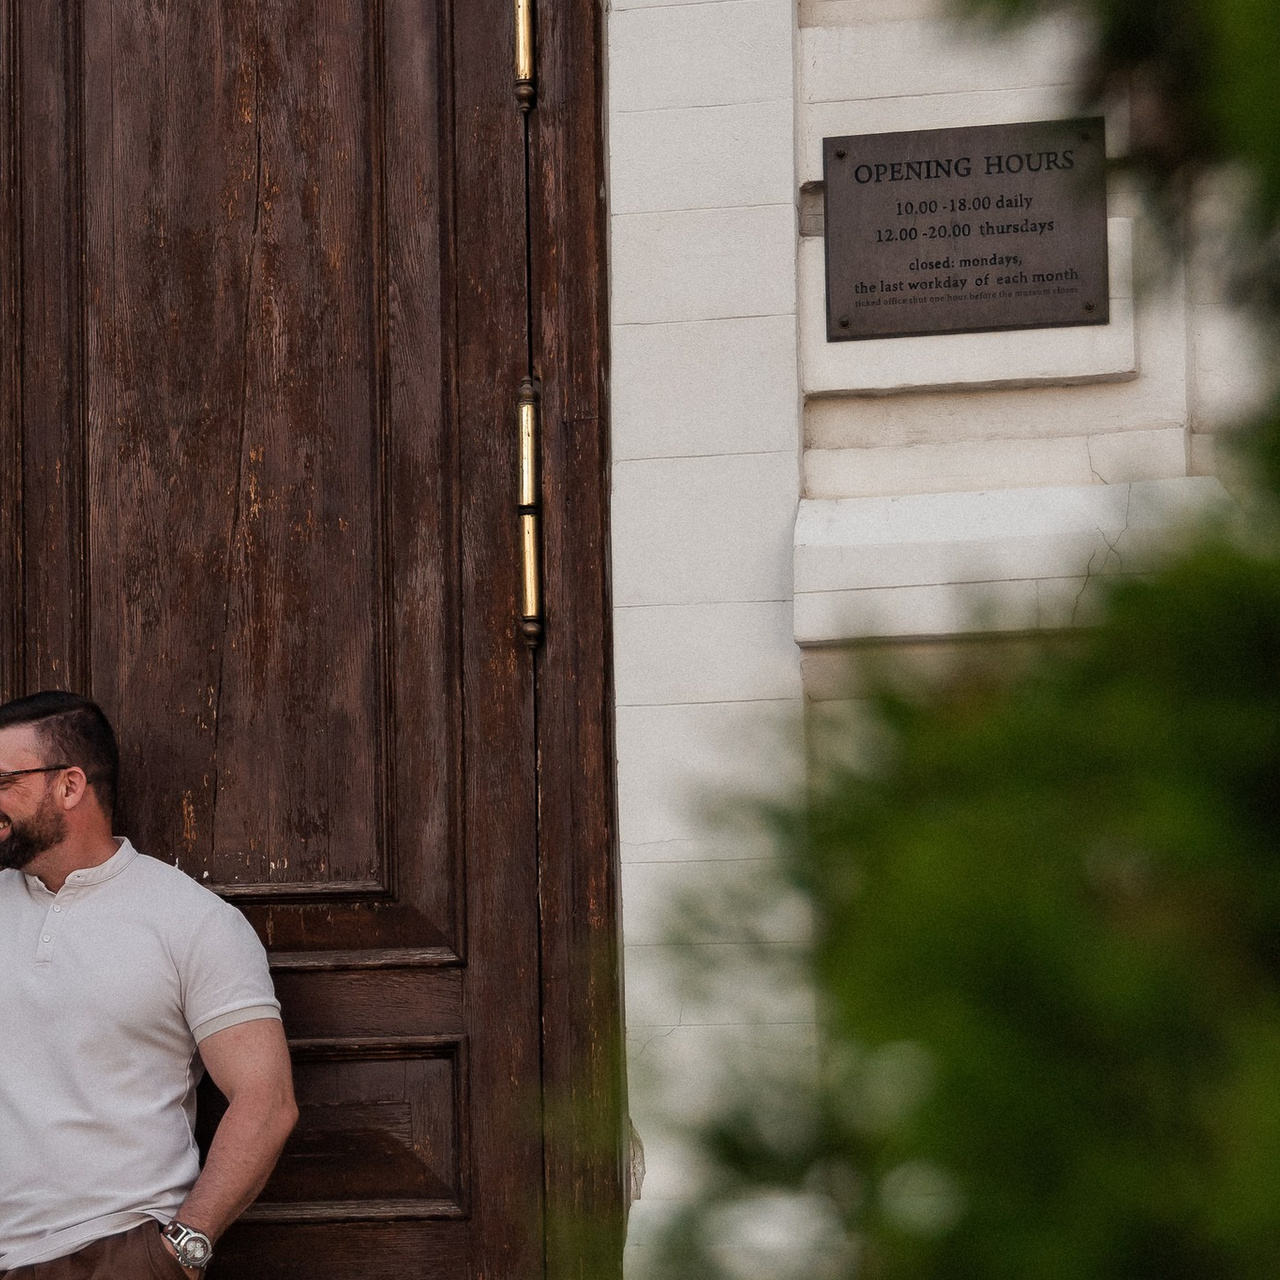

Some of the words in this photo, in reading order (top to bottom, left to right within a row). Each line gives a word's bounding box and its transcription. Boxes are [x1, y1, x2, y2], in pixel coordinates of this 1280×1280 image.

[854, 157, 972, 184] OPENING
[984, 150, 1074, 175] HOURS
[896, 200, 938, 216] 10.00
[995, 193, 1033, 210] daily
[876, 227, 918, 243] 12.00
[979, 219, 1055, 236] thursdays
[909, 256, 955, 271] closed:
[959, 253, 1023, 268] mondays,
[855, 281, 876, 294] the
[880, 280, 904, 292] last
[908, 276, 968, 290] workday
[975, 274, 990, 287] of
[996, 271, 1028, 285] each
[1031, 268, 1079, 282] month
[883, 298, 907, 306] office
[909, 296, 927, 305] shut
[929, 295, 945, 303] one
[947, 294, 968, 302] hour
[969, 291, 997, 300] before
[999, 290, 1012, 298] the
